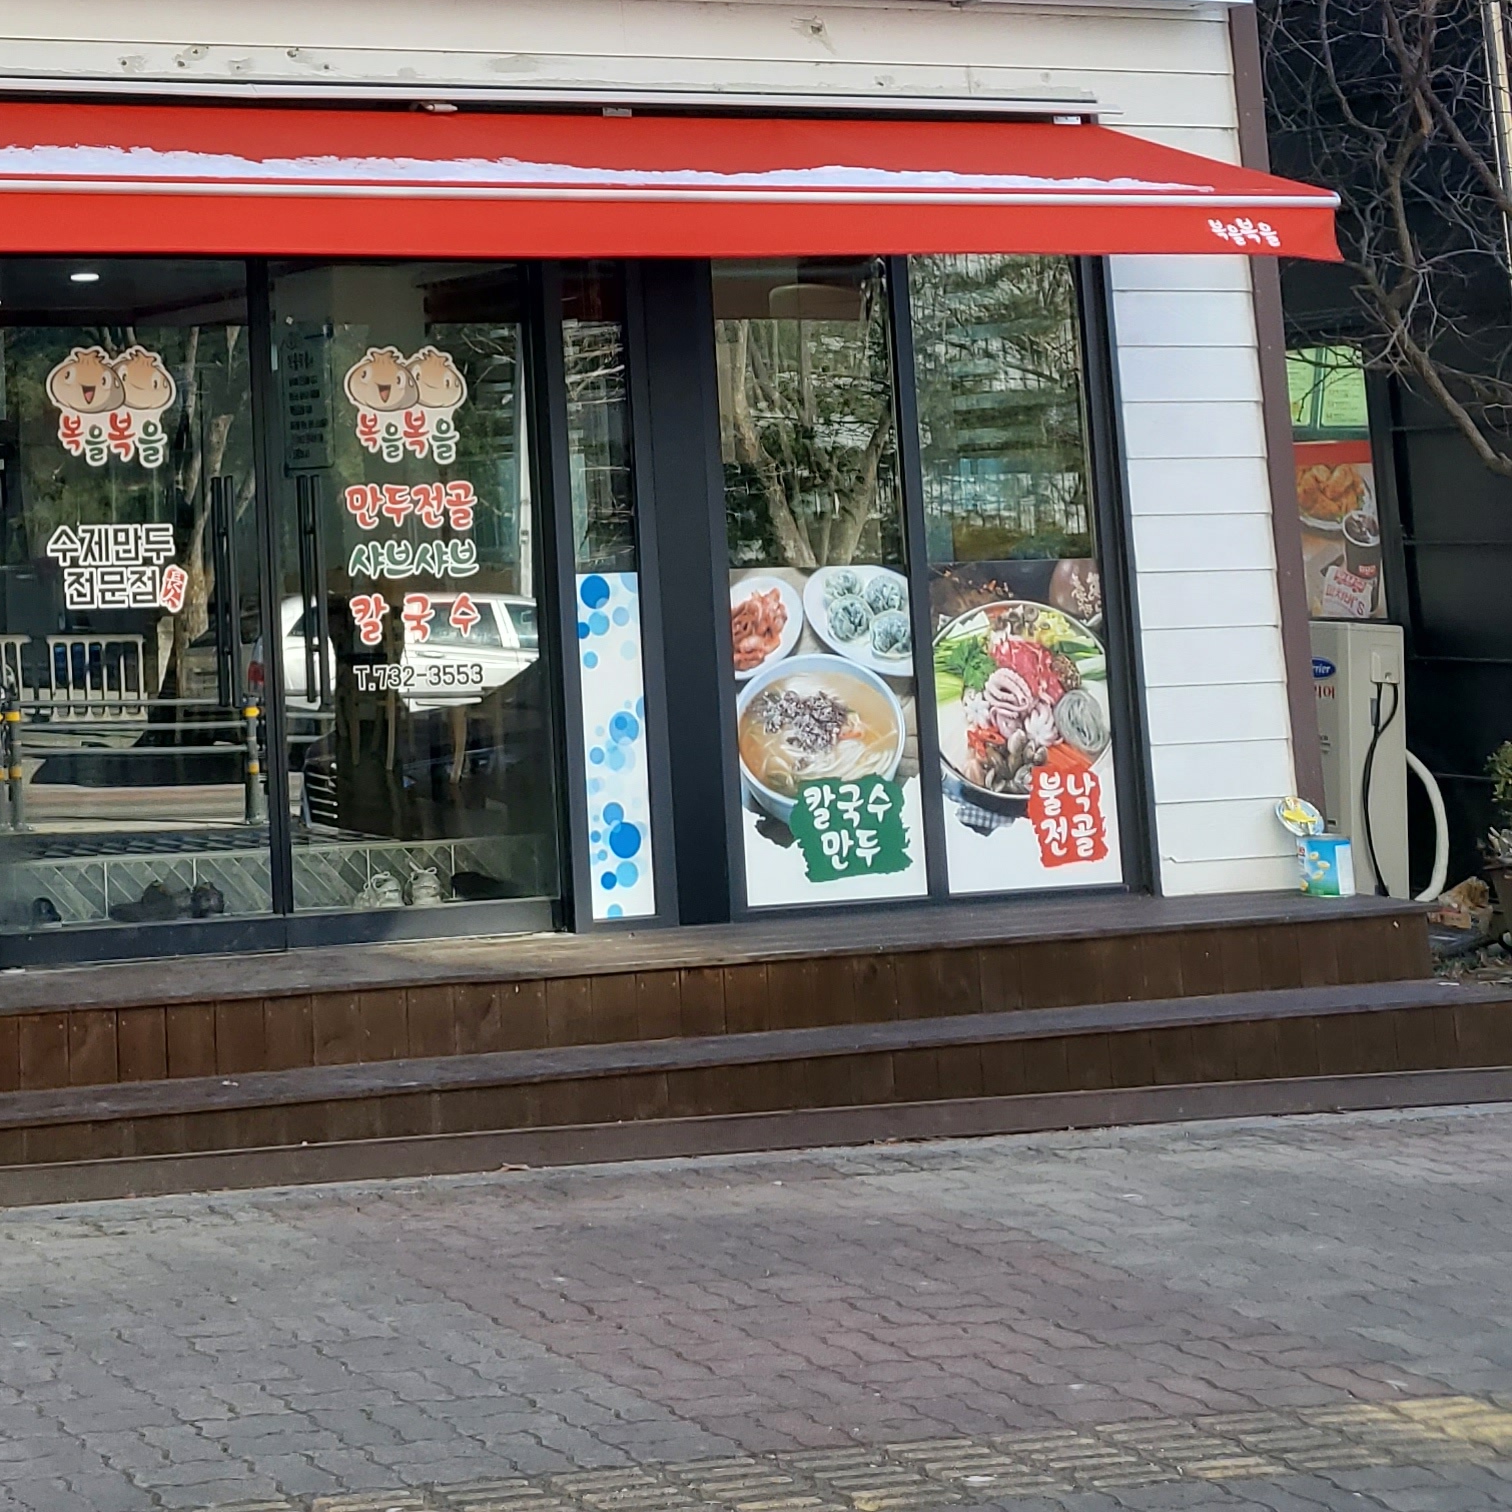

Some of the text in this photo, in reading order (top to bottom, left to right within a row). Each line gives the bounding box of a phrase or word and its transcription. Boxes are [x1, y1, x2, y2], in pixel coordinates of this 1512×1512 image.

[1207, 217, 1281, 247] 복을복을
[61, 410, 167, 463] 복을복을
[357, 410, 460, 463] 복을복을
[345, 480, 477, 530] 만두전골
[47, 524, 175, 566] 수제만두
[349, 539, 479, 578] 샤브샤브
[64, 567, 160, 609] 전문점
[353, 663, 484, 691] T.732-3553
[804, 782, 893, 829] 칼국수
[1038, 770, 1097, 813] 불낙
[820, 829, 882, 871] 만두
[1039, 816, 1098, 858] 전골
